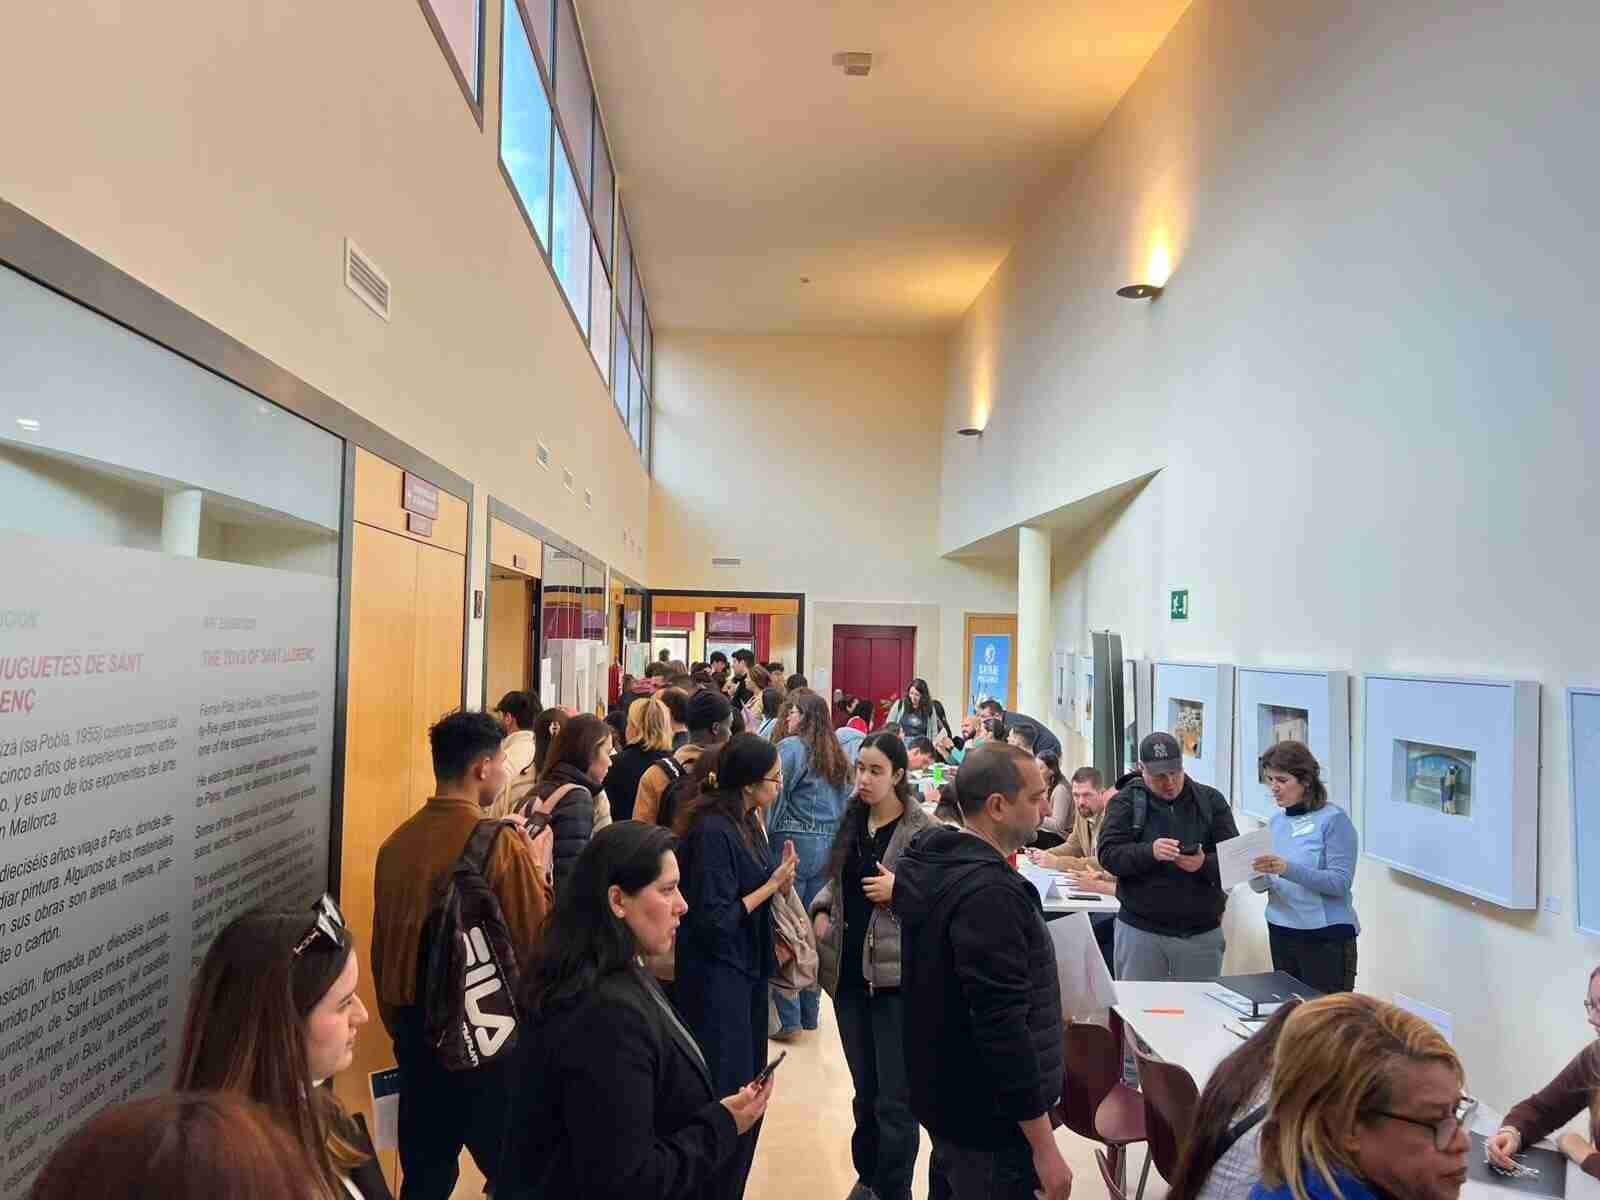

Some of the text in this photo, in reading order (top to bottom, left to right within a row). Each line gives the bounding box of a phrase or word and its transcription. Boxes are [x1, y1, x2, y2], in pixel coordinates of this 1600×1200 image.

[85, 654, 105, 675] DE
[108, 652, 144, 673] SANT
[0, 764, 31, 784] cinco
[33, 760, 61, 778] años
[63, 756, 78, 772] de
[79, 748, 132, 768] experiencia
[134, 743, 158, 758] como
[14, 794, 23, 813] y
[24, 791, 38, 806] es
[41, 785, 61, 802] uno
[63, 779, 77, 797] de
[79, 776, 94, 793] los
[95, 766, 148, 789] exponentes
[148, 761, 160, 776] del
[9, 811, 59, 837] Mallorca.
[0, 852, 48, 882] dieciséis
[50, 842, 76, 866] años
[77, 837, 100, 857] viaja
[101, 836, 107, 849] a
[21, 876, 62, 907] pintura.
[64, 860, 104, 886] Algunos
[105, 854, 118, 869] de
[118, 849, 131, 864] los
[10, 913, 31, 933] sus
[34, 899, 65, 923] obras
[68, 890, 88, 909] son
[14, 943, 22, 958] o
[42, 951, 85, 985] formada
[88, 943, 106, 967] por
[30, 996, 49, 1022] por
[51, 987, 66, 1005] los
[68, 966, 104, 998] lugares
[105, 954, 125, 977] más
[48, 1013, 62, 1034] de
[65, 999, 90, 1023] Sant
